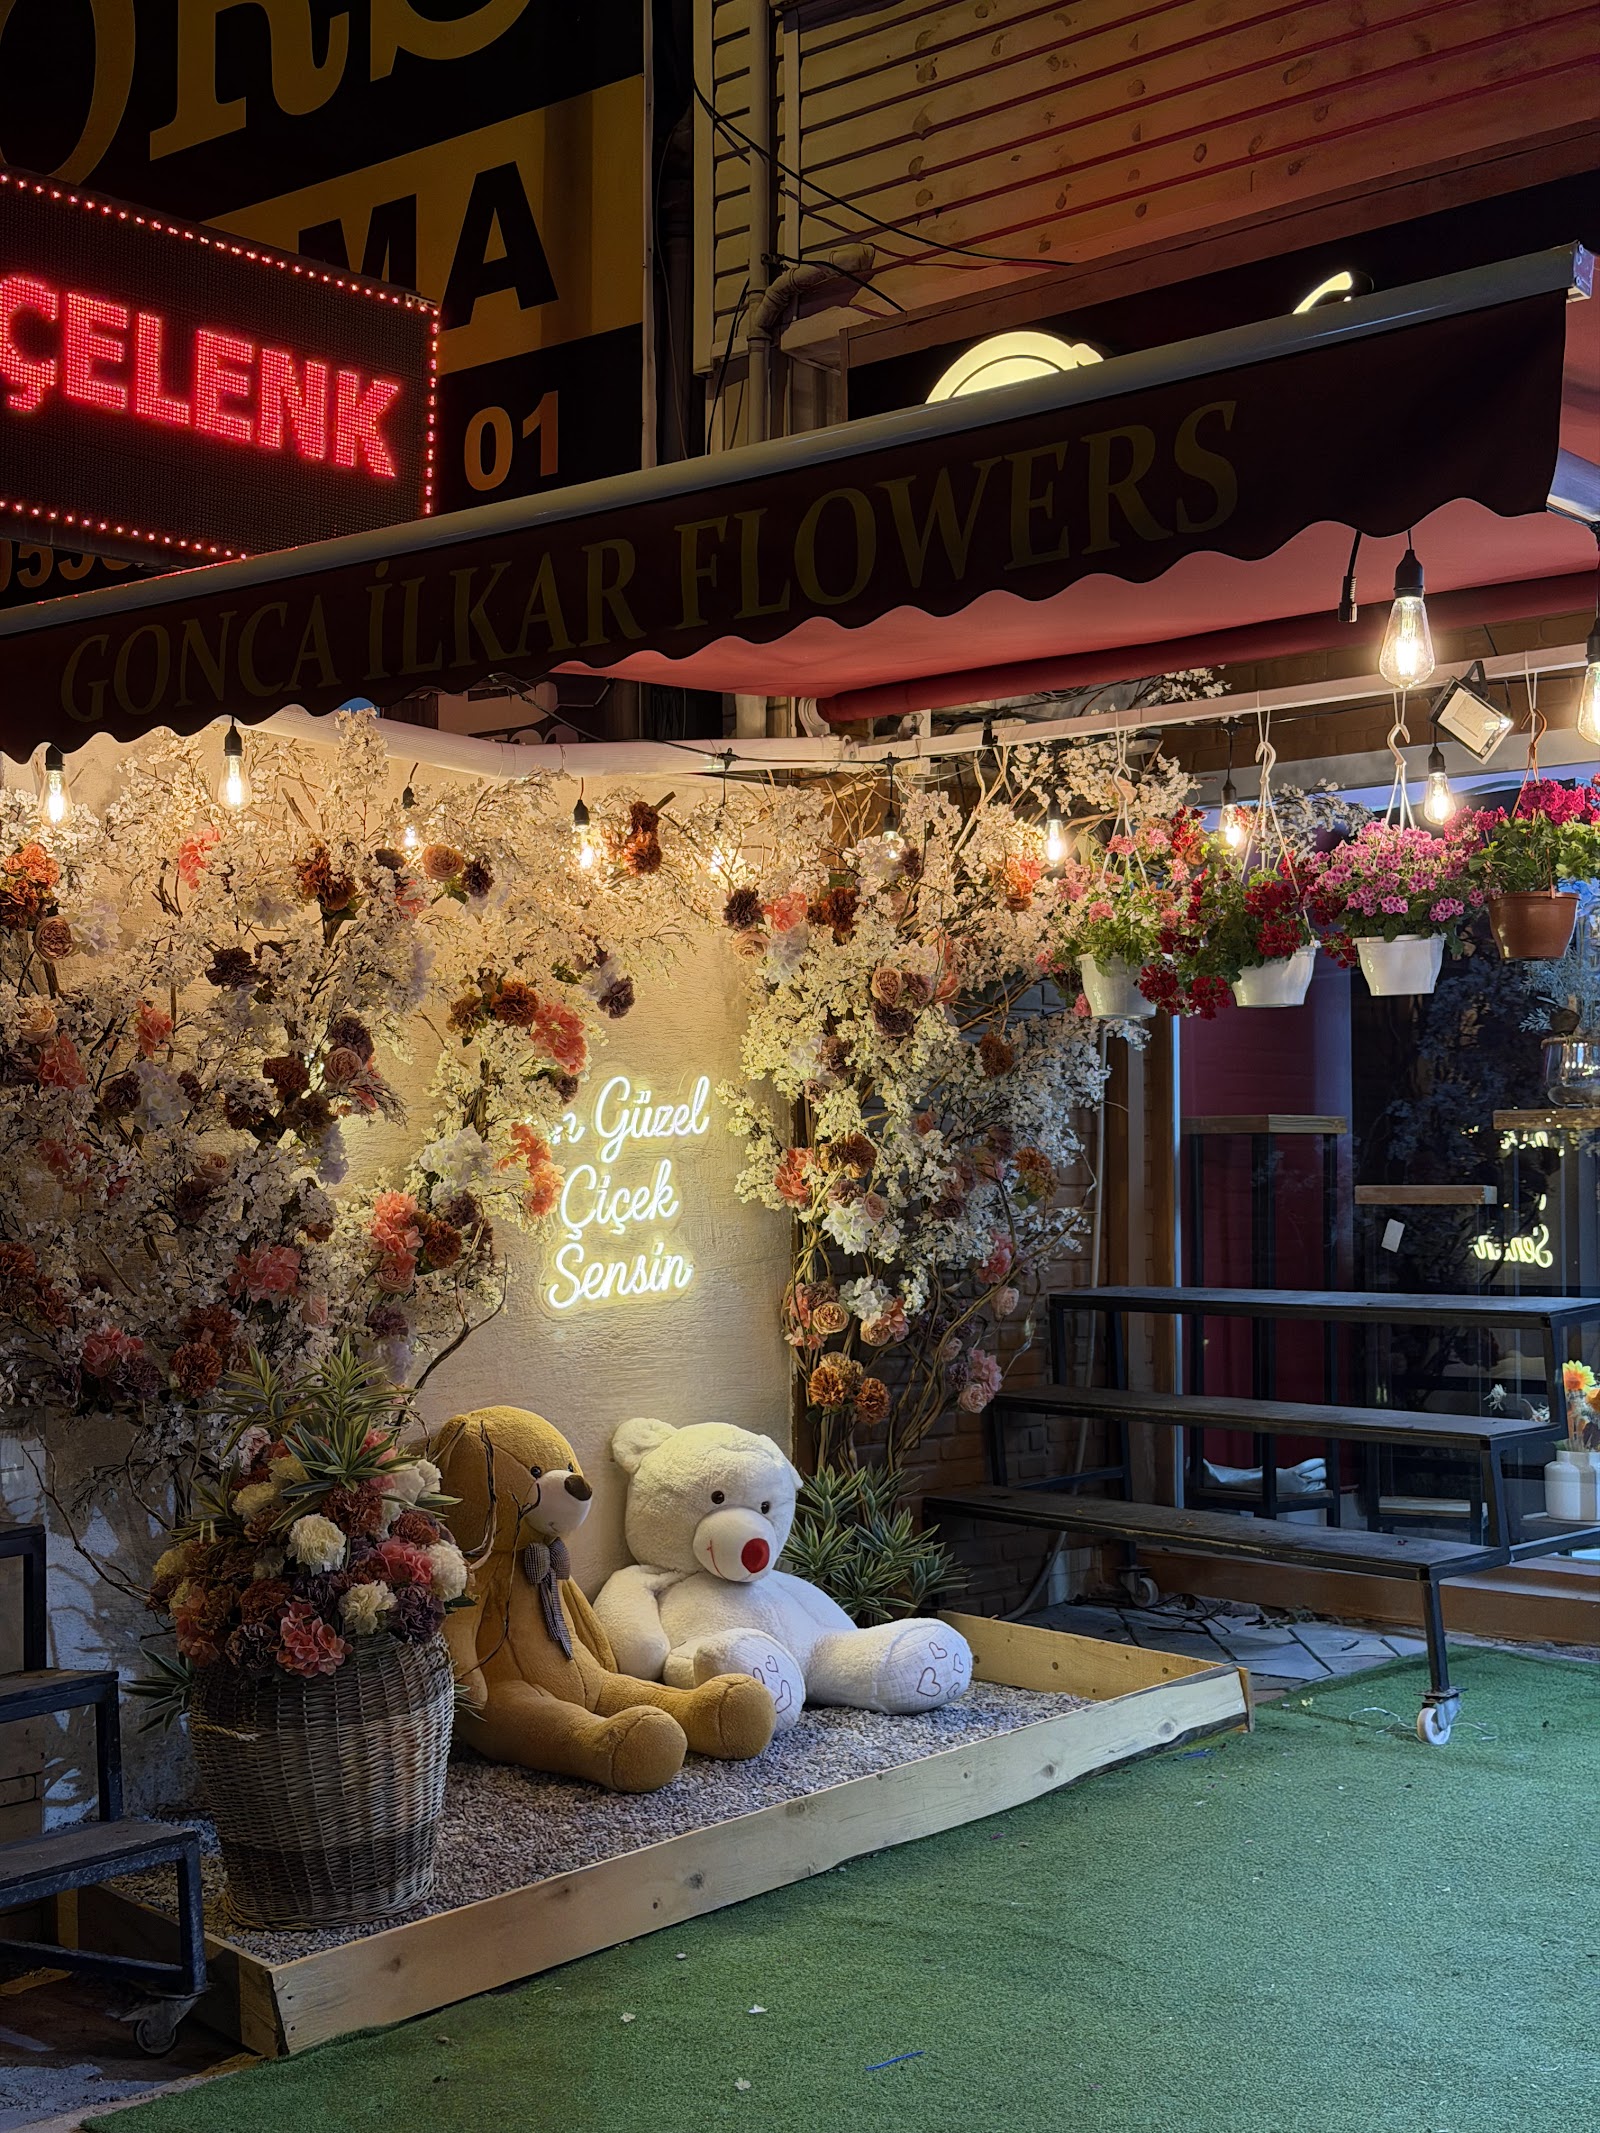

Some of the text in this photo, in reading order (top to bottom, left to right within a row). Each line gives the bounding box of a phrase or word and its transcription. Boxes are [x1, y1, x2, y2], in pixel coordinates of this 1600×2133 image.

[0, 275, 400, 478] ÇELENK
[463, 391, 559, 490] 01
[59, 400, 1240, 725] GONCA İLKAR FLOWERS
[595, 1076, 710, 1163] Güzel
[560, 1159, 679, 1240] Çiçek
[549, 1242, 695, 1310] Sensin
